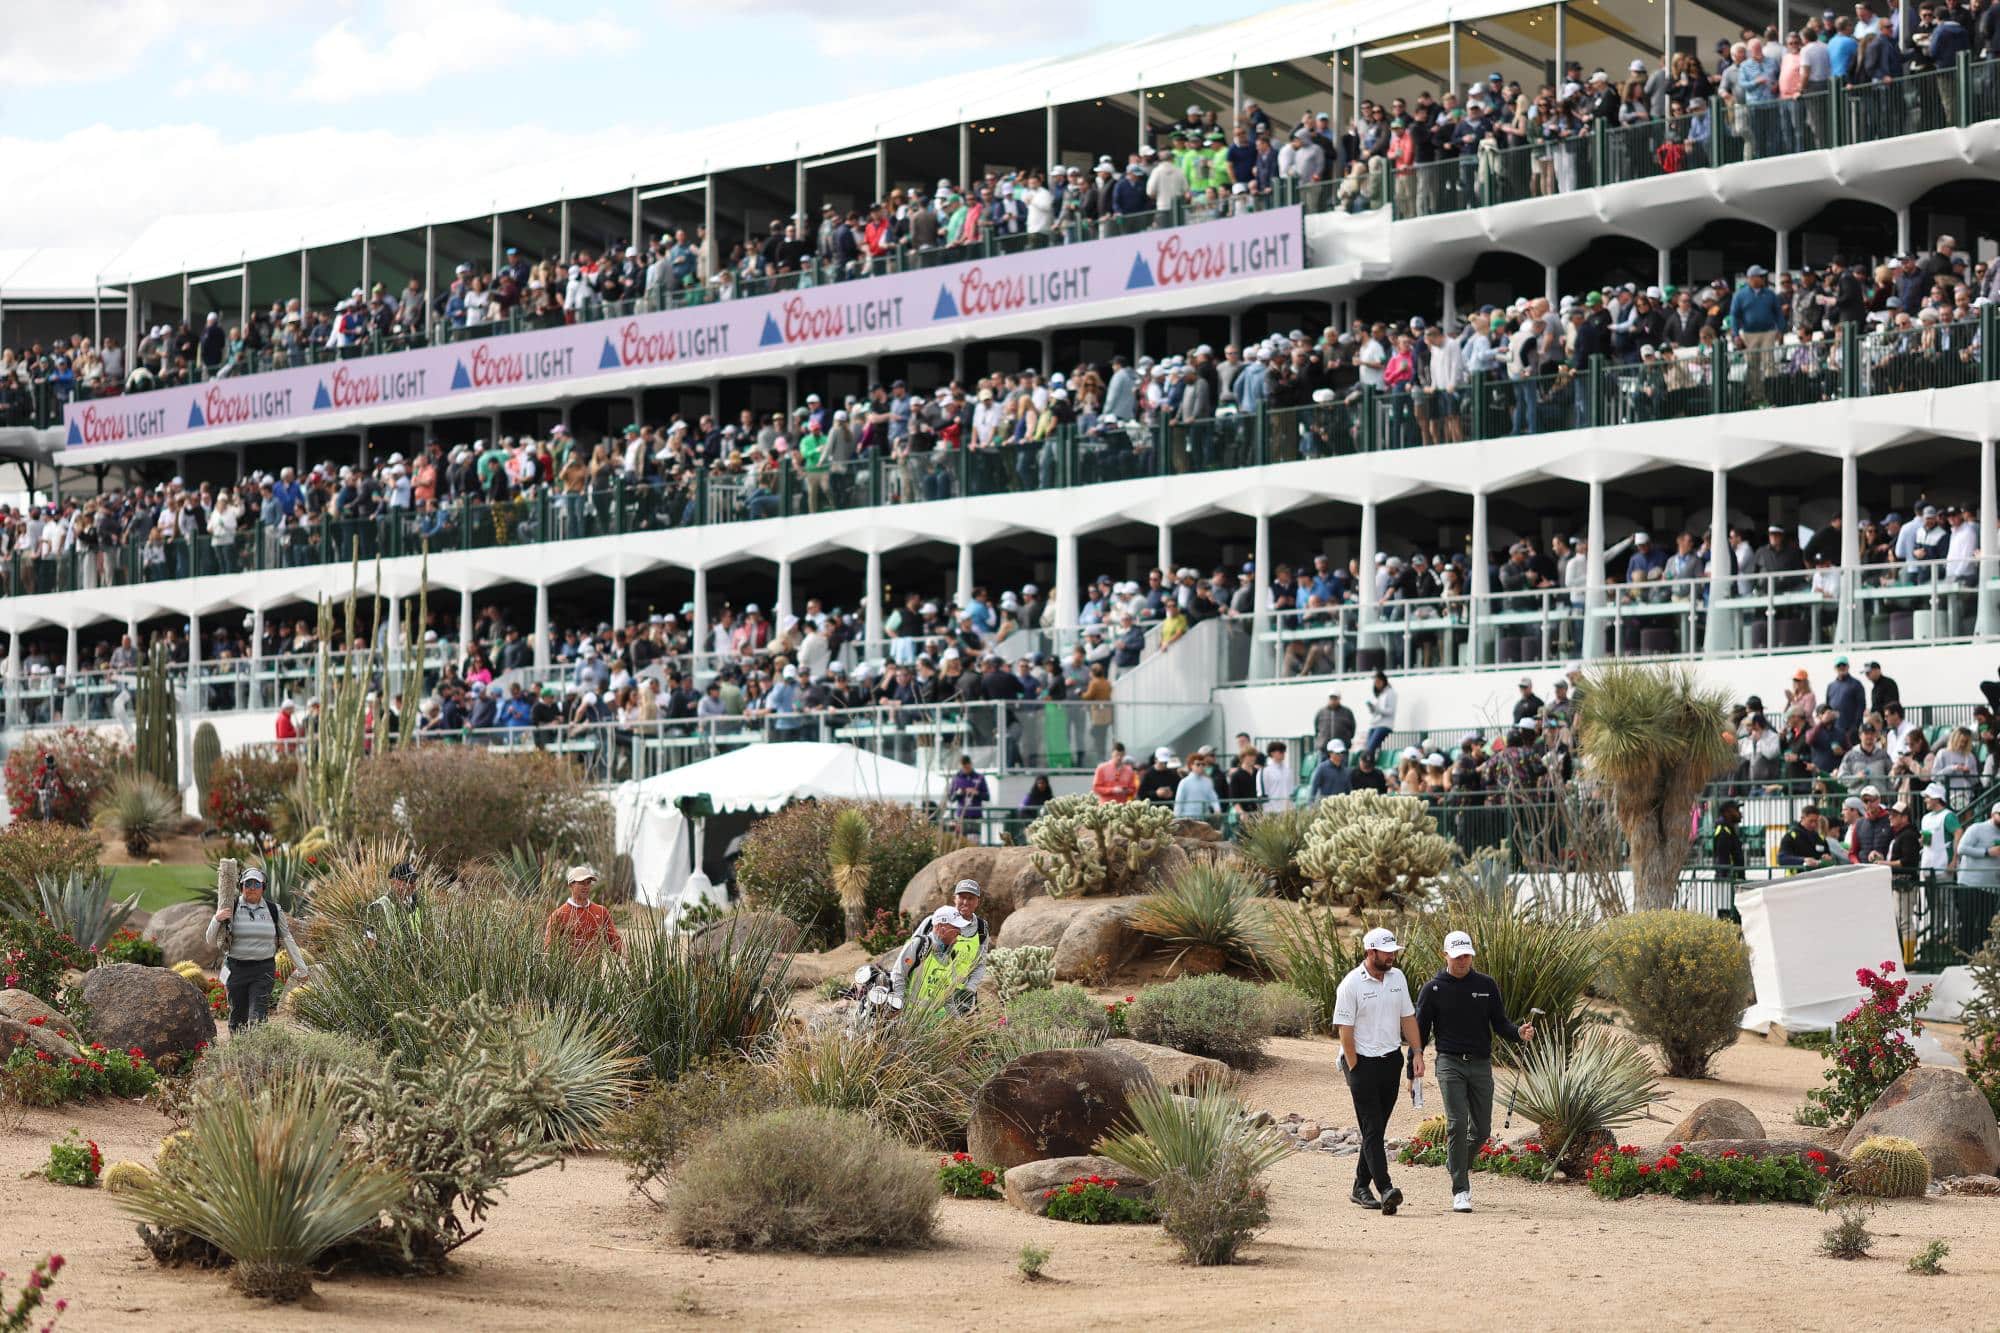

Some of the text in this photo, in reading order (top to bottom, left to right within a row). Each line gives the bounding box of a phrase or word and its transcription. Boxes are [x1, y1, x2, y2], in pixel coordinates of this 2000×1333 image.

[1155, 233, 1290, 287] Coors LIGHT
[958, 266, 1090, 316] Coors LIGHT
[783, 296, 904, 344] Coors LIGHT
[470, 343, 575, 388] Coors LIGHT
[620, 321, 729, 367] Coors LIGHT
[205, 386, 293, 426] Coors LIGHT
[331, 366, 427, 407] Coors LIGHT
[82, 405, 166, 444] Coors LIGHT
